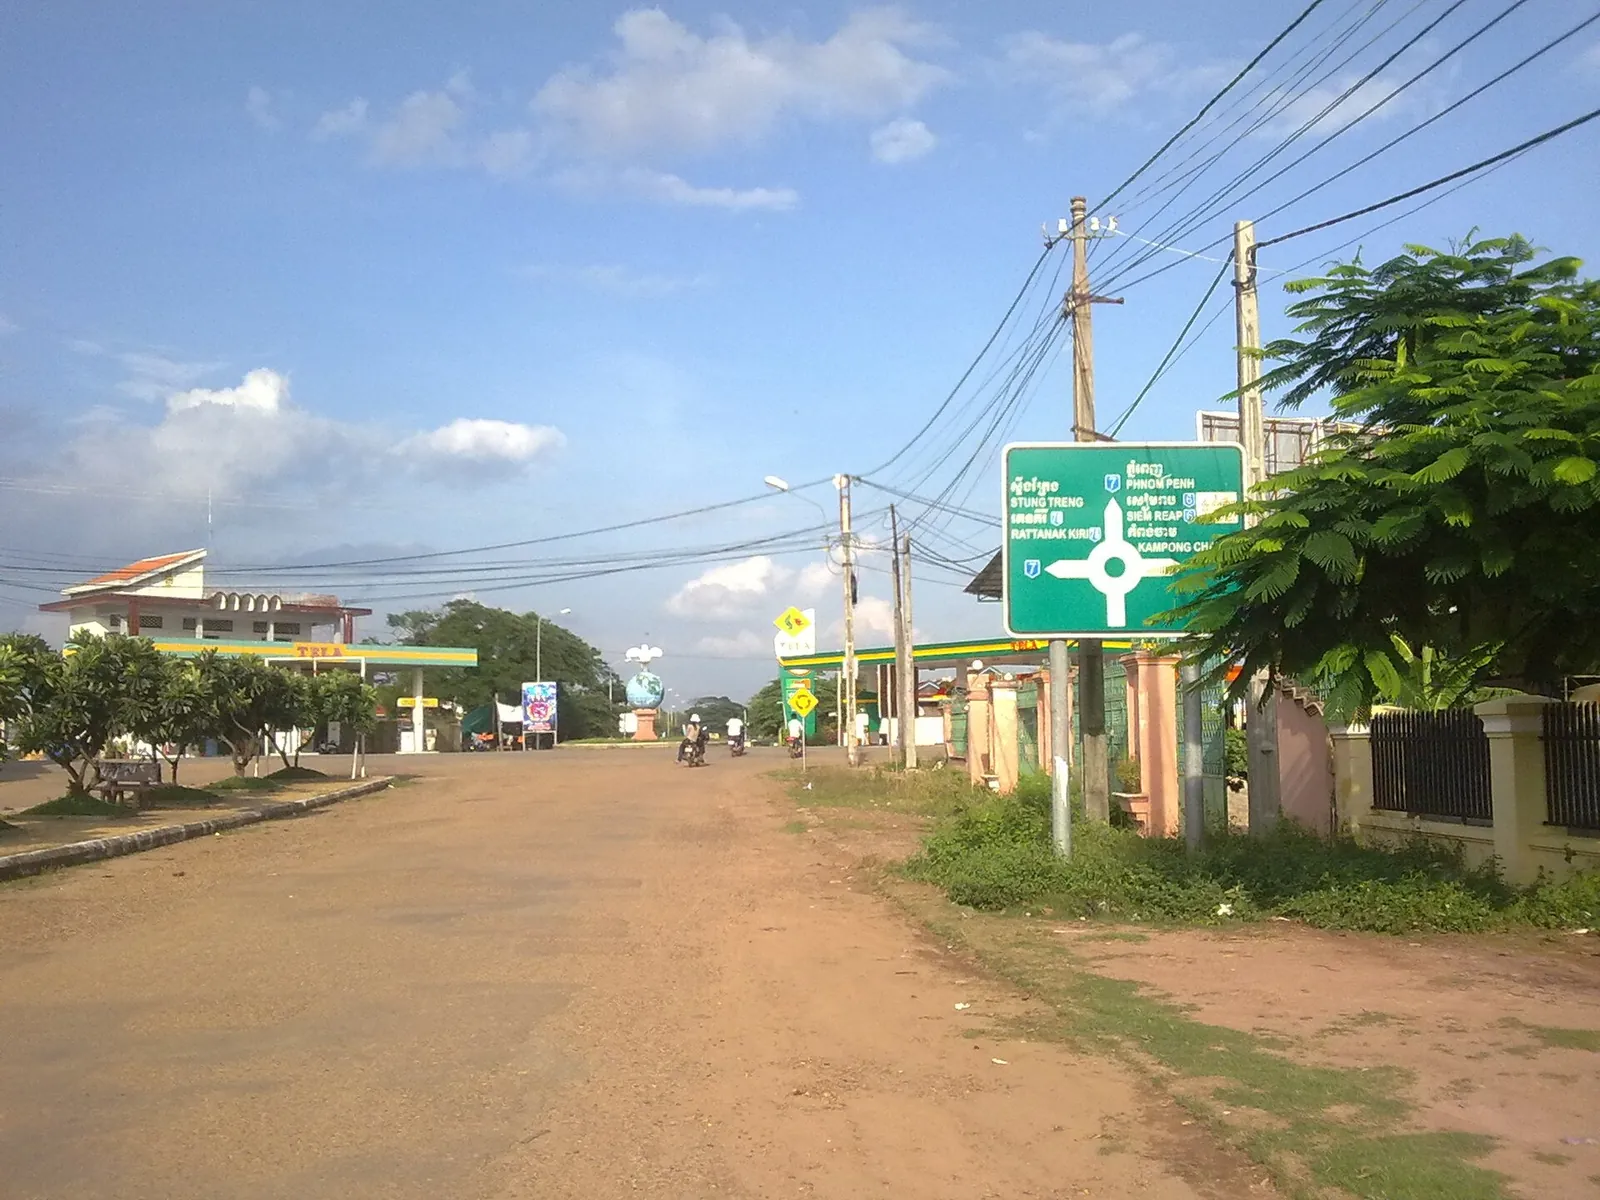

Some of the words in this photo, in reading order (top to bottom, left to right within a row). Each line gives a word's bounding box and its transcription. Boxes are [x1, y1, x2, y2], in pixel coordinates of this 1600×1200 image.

[1126, 478, 1164, 490] PHNOM
[1166, 478, 1195, 490] PENH
[1010, 497, 1046, 508] STUNG
[1047, 497, 1084, 508] TRENG
[1126, 511, 1152, 522] SIEM
[1154, 511, 1183, 522] REAP
[1010, 528, 1067, 540] RATTANAK
[1068, 528, 1089, 540] KIRI
[1137, 542, 1192, 553] KAMPONG
[296, 646, 343, 658] TELA
